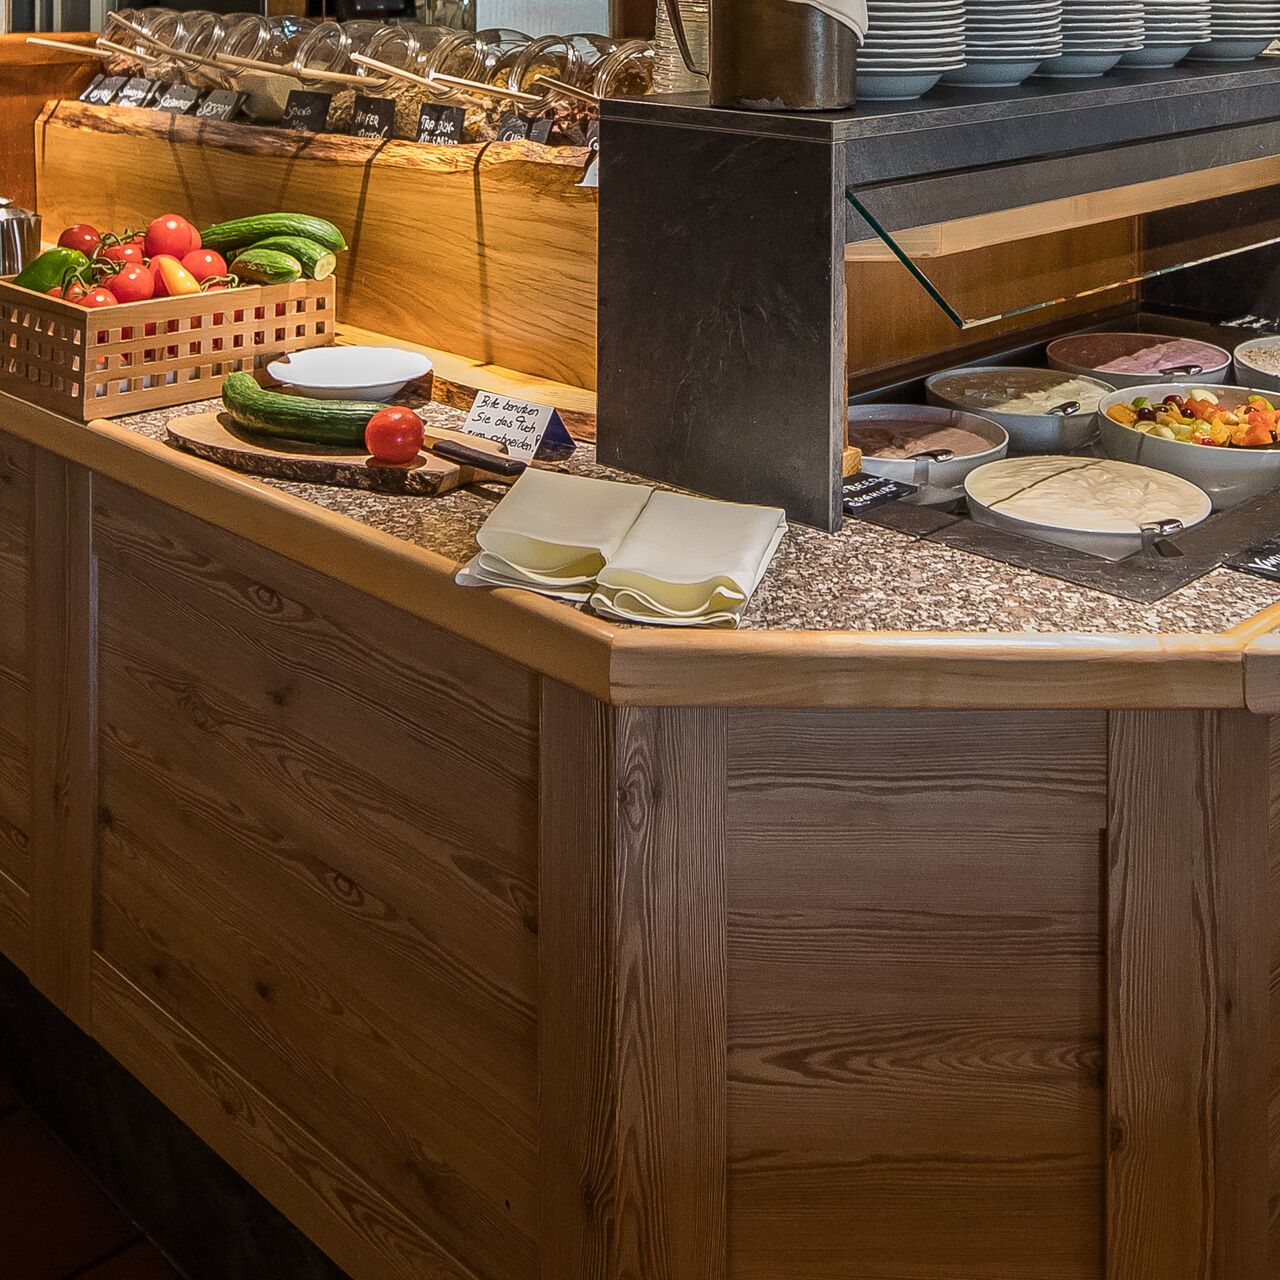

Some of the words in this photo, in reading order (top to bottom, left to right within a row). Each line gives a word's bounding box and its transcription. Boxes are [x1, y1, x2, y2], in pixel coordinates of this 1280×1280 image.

[476, 395, 500, 410] Bitte
[471, 411, 491, 424] Sie
[494, 416, 513, 428] das
[515, 415, 537, 434] Tuch
